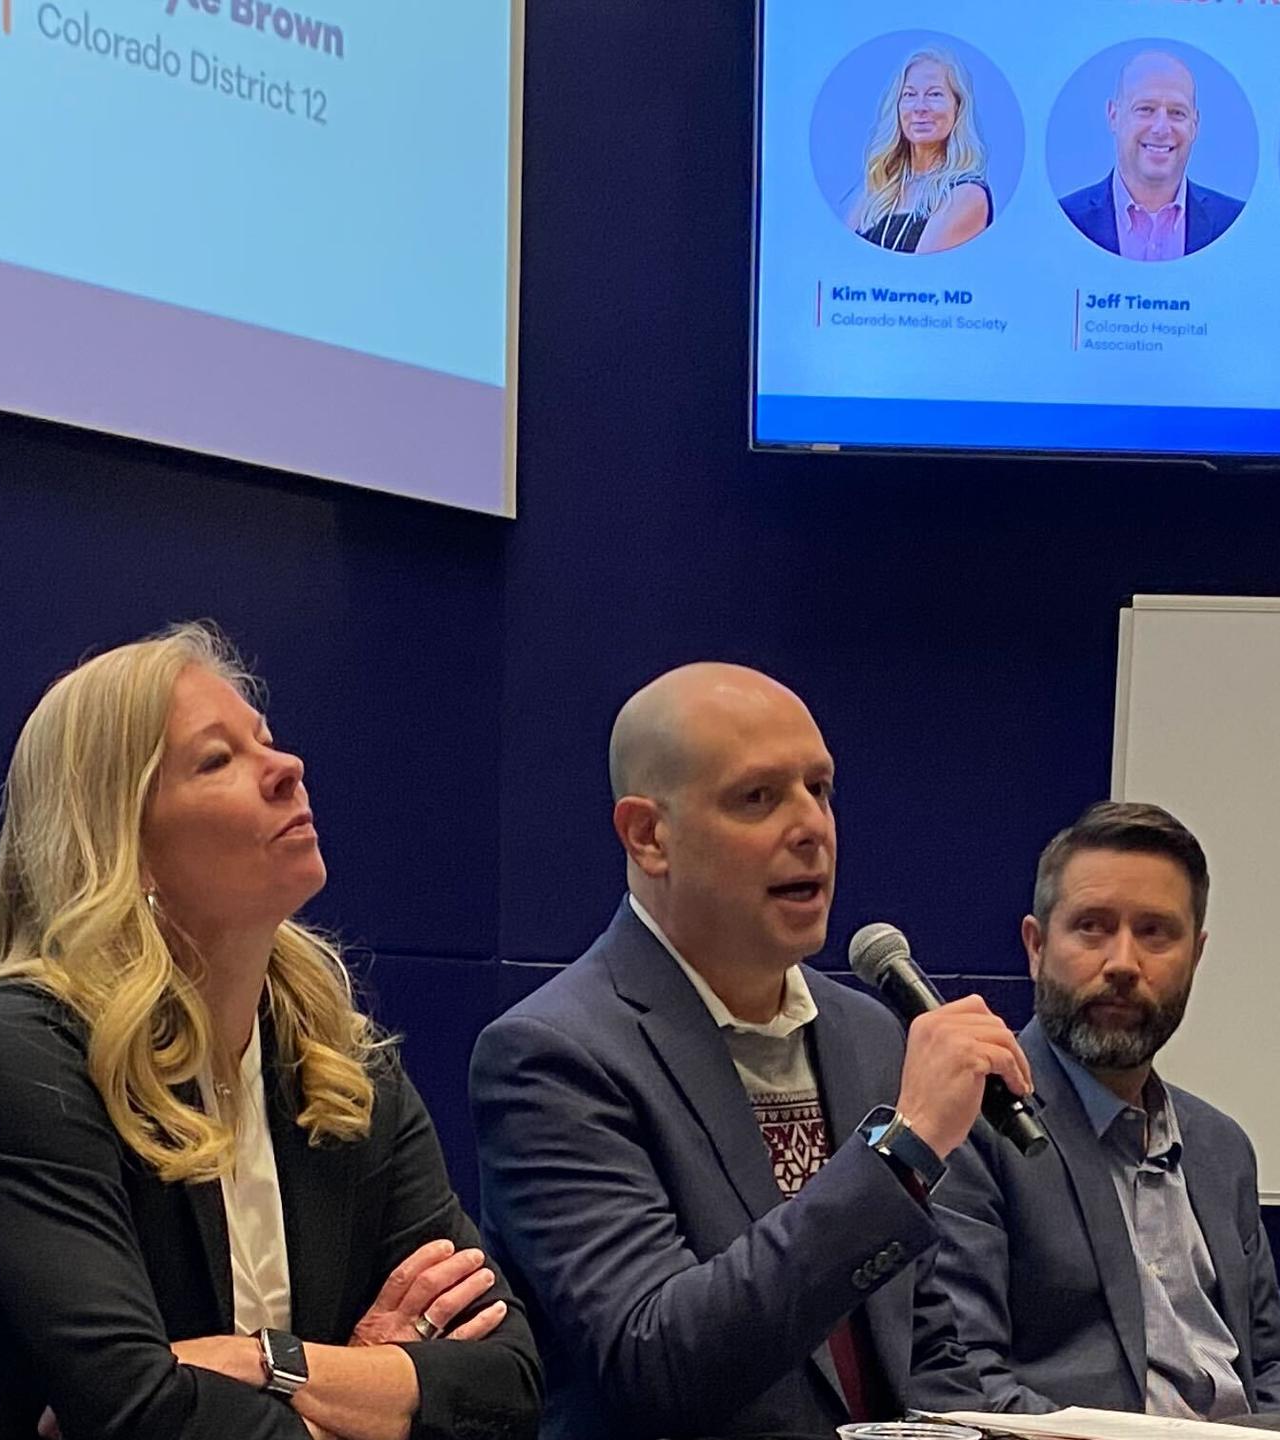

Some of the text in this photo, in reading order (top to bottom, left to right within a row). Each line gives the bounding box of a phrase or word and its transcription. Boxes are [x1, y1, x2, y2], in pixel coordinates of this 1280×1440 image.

[231, 0, 344, 58] Brown
[37, 2, 328, 126] Colorado District 12
[832, 286, 973, 305] Kim Warner, MD
[1085, 294, 1190, 311] Jeff Tieman
[831, 312, 1008, 333] Colorado Medical Society
[1085, 320, 1208, 337] Colorado Hospital
[1084, 338, 1163, 351] Association
